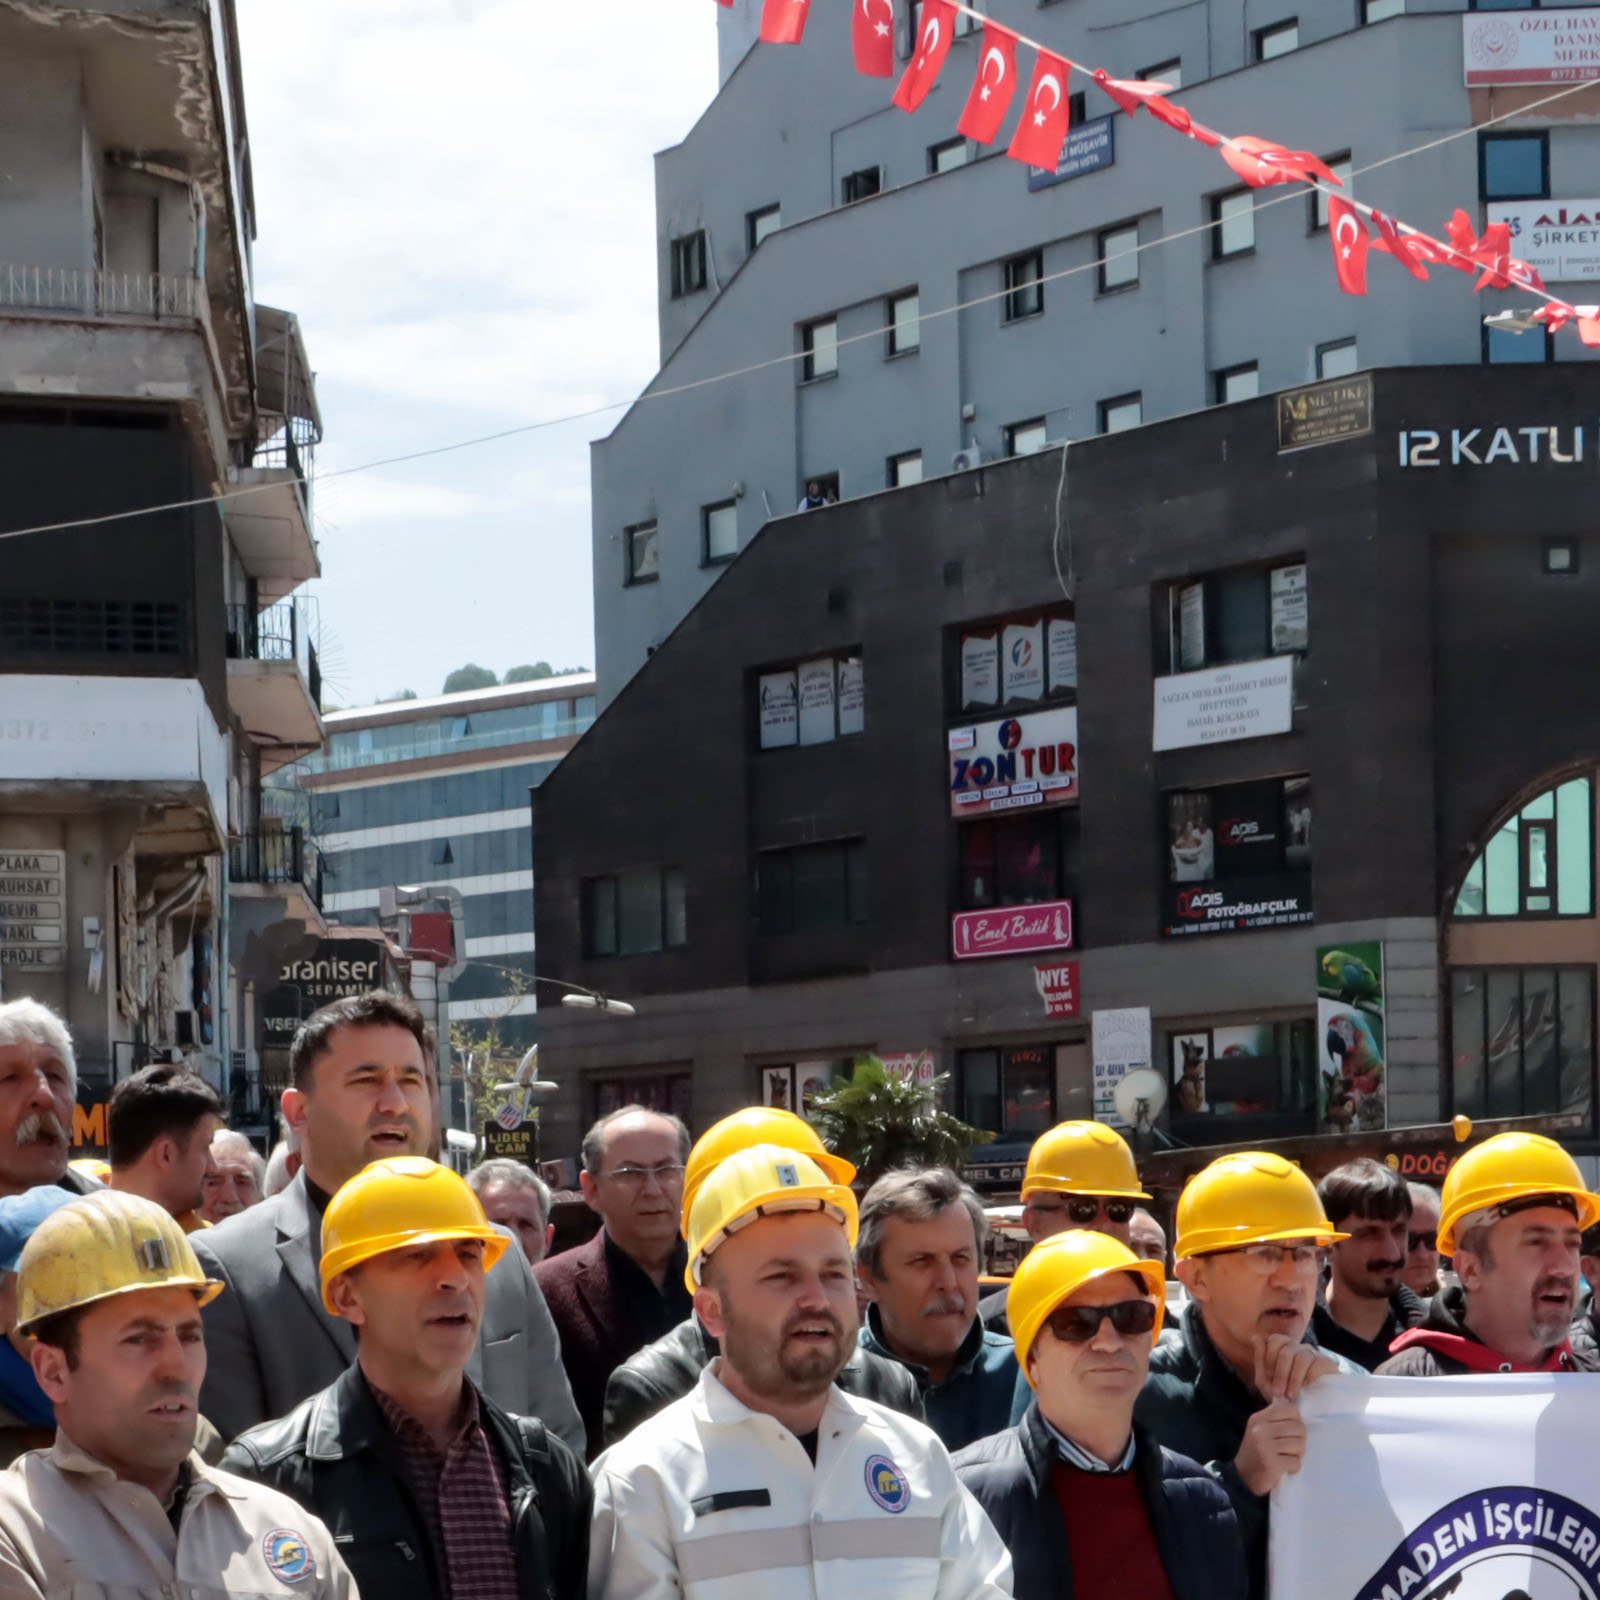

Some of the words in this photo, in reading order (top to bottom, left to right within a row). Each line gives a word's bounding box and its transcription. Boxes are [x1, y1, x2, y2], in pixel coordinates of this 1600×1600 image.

[1519, 18, 1565, 33] ÖZEL
[1399, 430, 1441, 466] 12
[1451, 425, 1583, 465] KATLI
[0, 879, 51, 894] RUHSAT
[1207, 898, 1298, 919] FOTOĞRAFÇILIK
[973, 919, 1009, 945] Emel
[1010, 914, 1050, 938] Butik
[0, 949, 44, 965] PROJE
[494, 1143, 527, 1154] CAM
